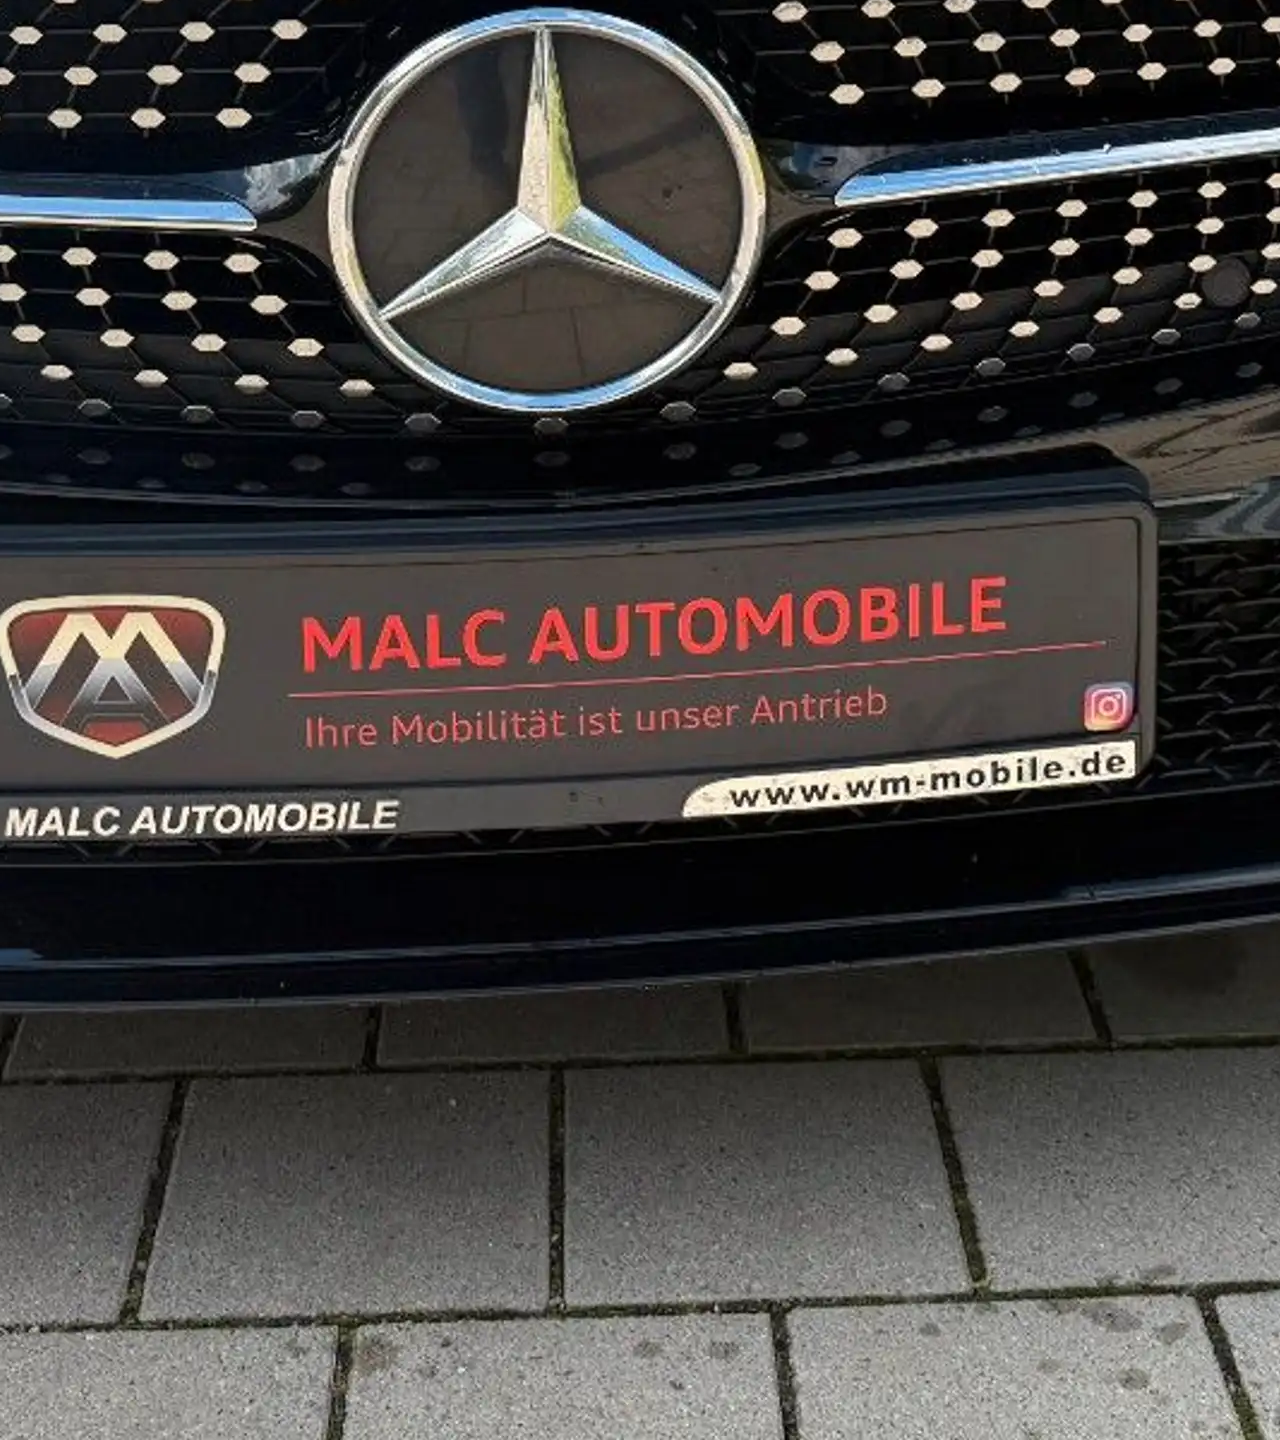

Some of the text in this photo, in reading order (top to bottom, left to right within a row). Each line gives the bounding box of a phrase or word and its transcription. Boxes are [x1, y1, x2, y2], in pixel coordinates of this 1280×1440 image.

[301, 576, 1007, 673] MALC AUTOMOBILE
[305, 685, 888, 749] Ihre Mobilität ist unser Antrieb
[729, 751, 1126, 808] www.wm-mobile.de
[4, 799, 401, 838] MALC AUTOMOBILE
